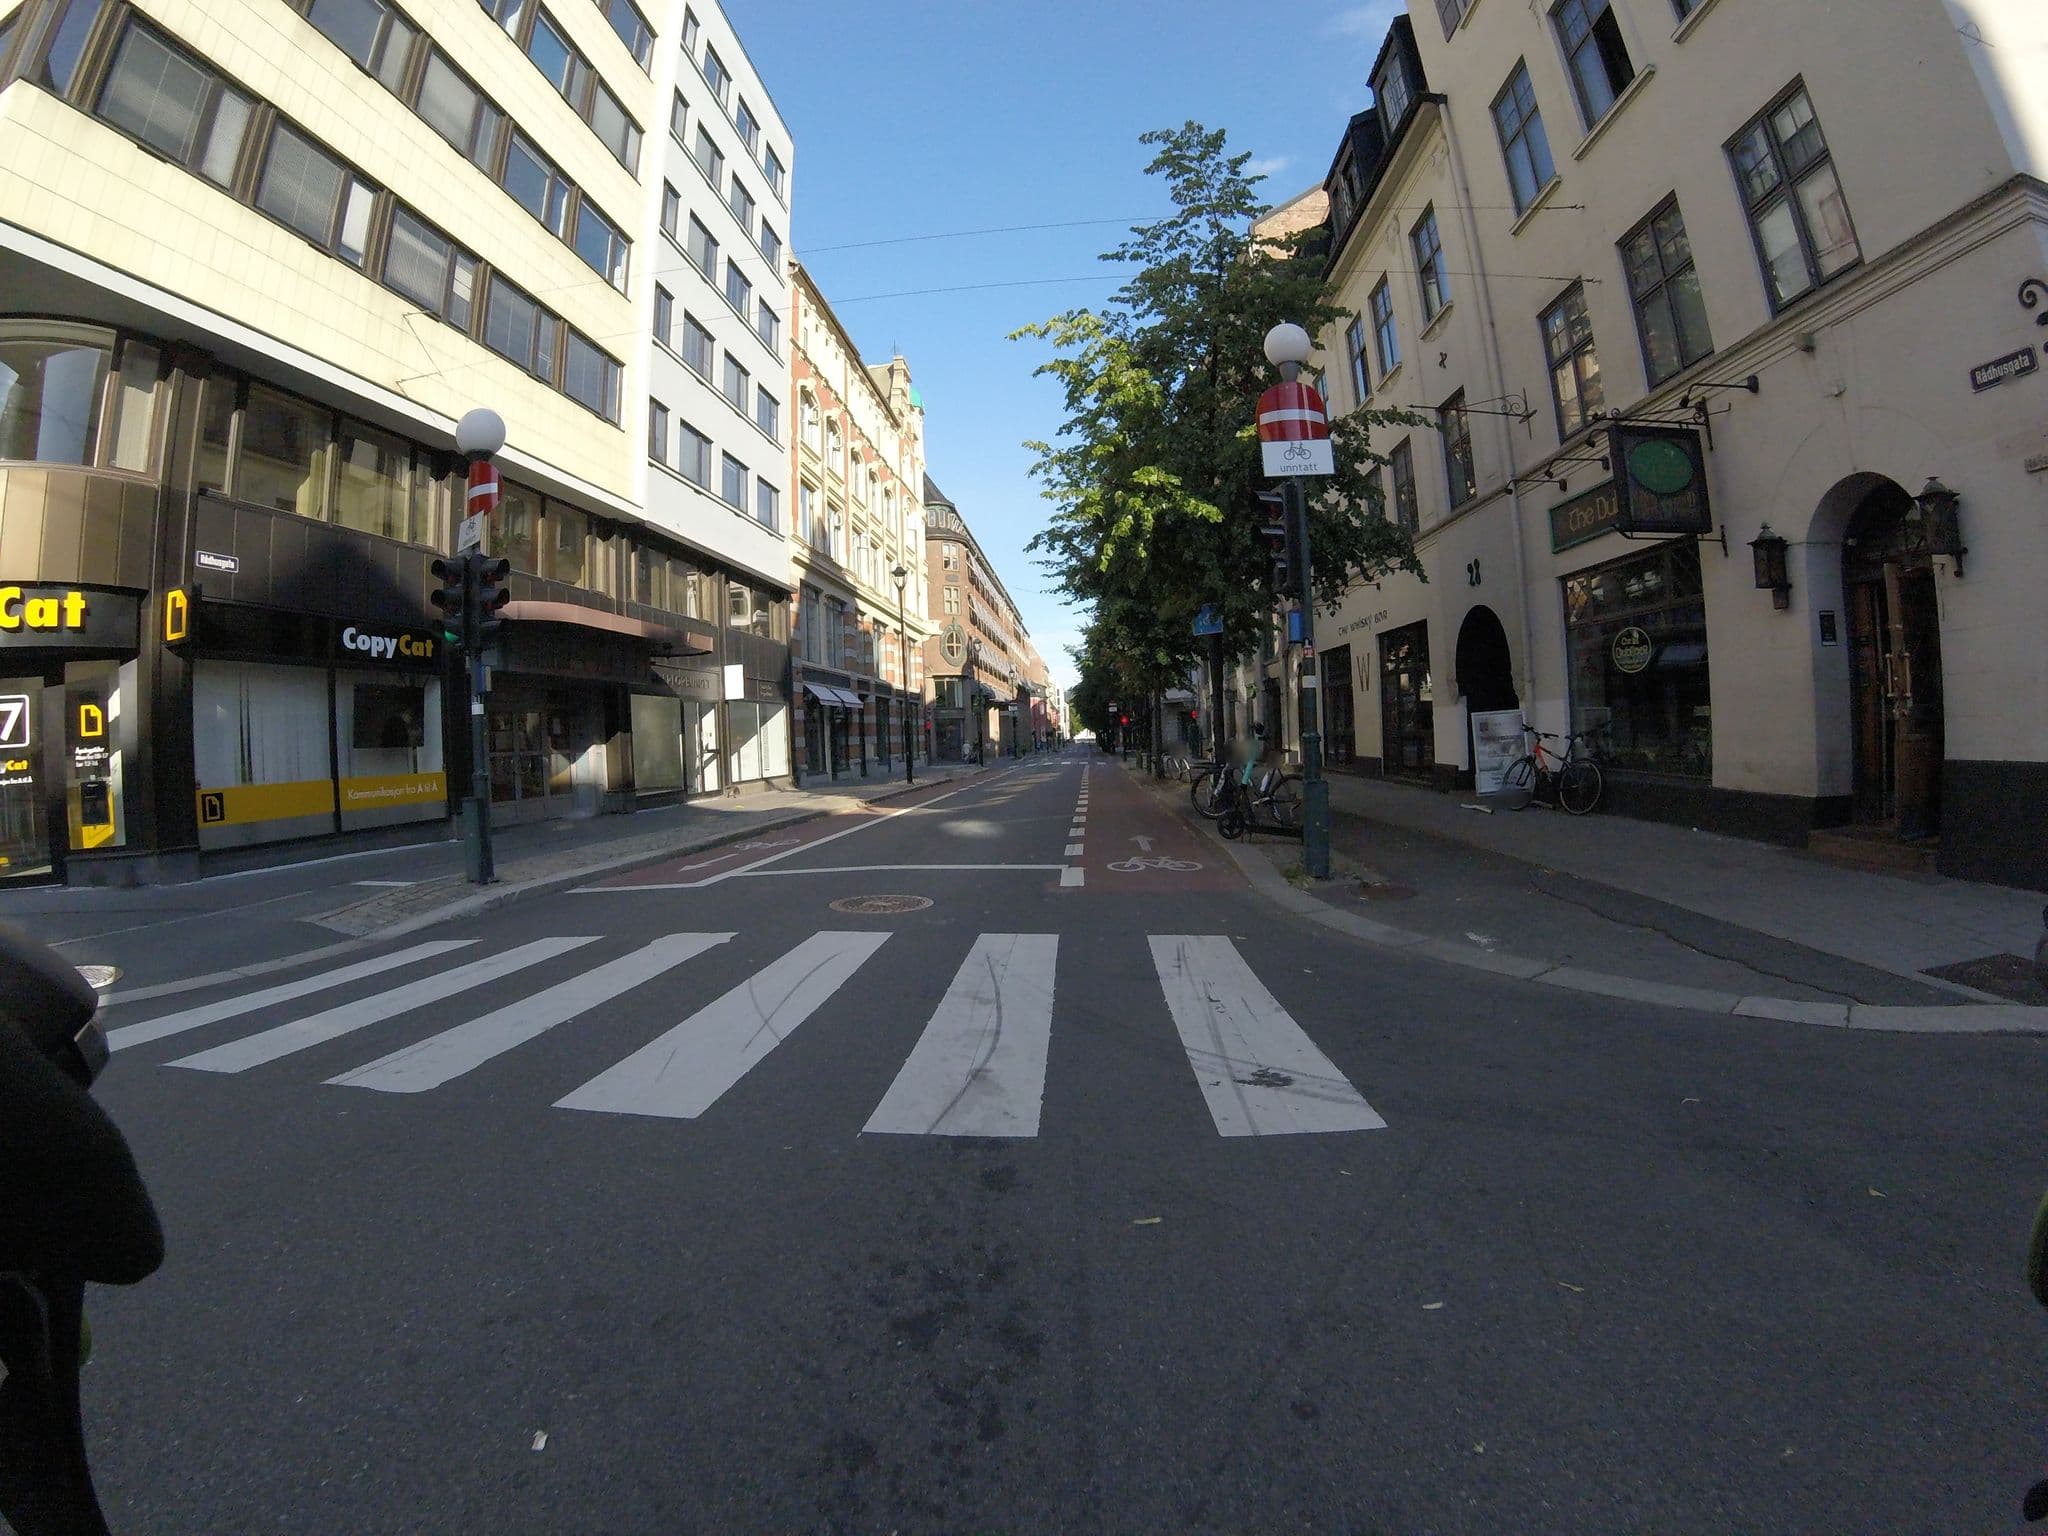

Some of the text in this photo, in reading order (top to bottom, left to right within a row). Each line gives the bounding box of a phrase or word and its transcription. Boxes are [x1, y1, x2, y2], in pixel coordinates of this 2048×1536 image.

[1975, 355, 2031, 385] Rådhusgata
[1280, 463, 1318, 473] unntatt
[1568, 508, 1595, 533] The
[1356, 652, 1370, 692] W
